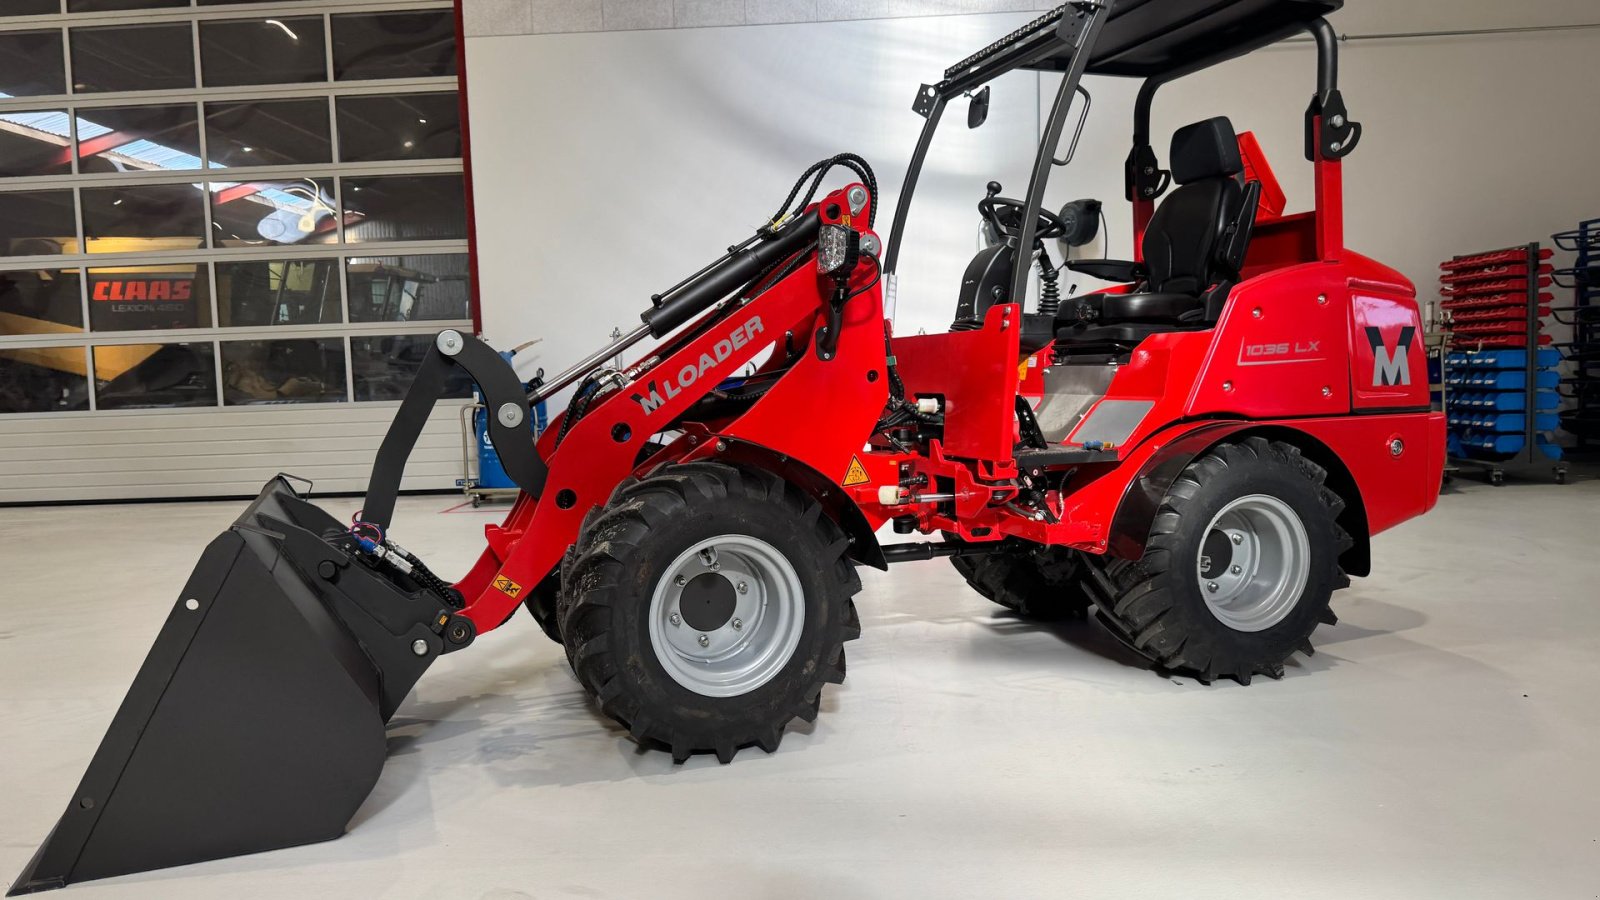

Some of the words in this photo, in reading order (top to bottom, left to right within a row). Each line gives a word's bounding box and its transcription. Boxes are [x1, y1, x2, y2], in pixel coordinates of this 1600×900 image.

[92, 280, 192, 301] CLAAS
[663, 315, 765, 400] LOADER
[1246, 342, 1290, 357] 1036
[1295, 340, 1321, 353] LX
